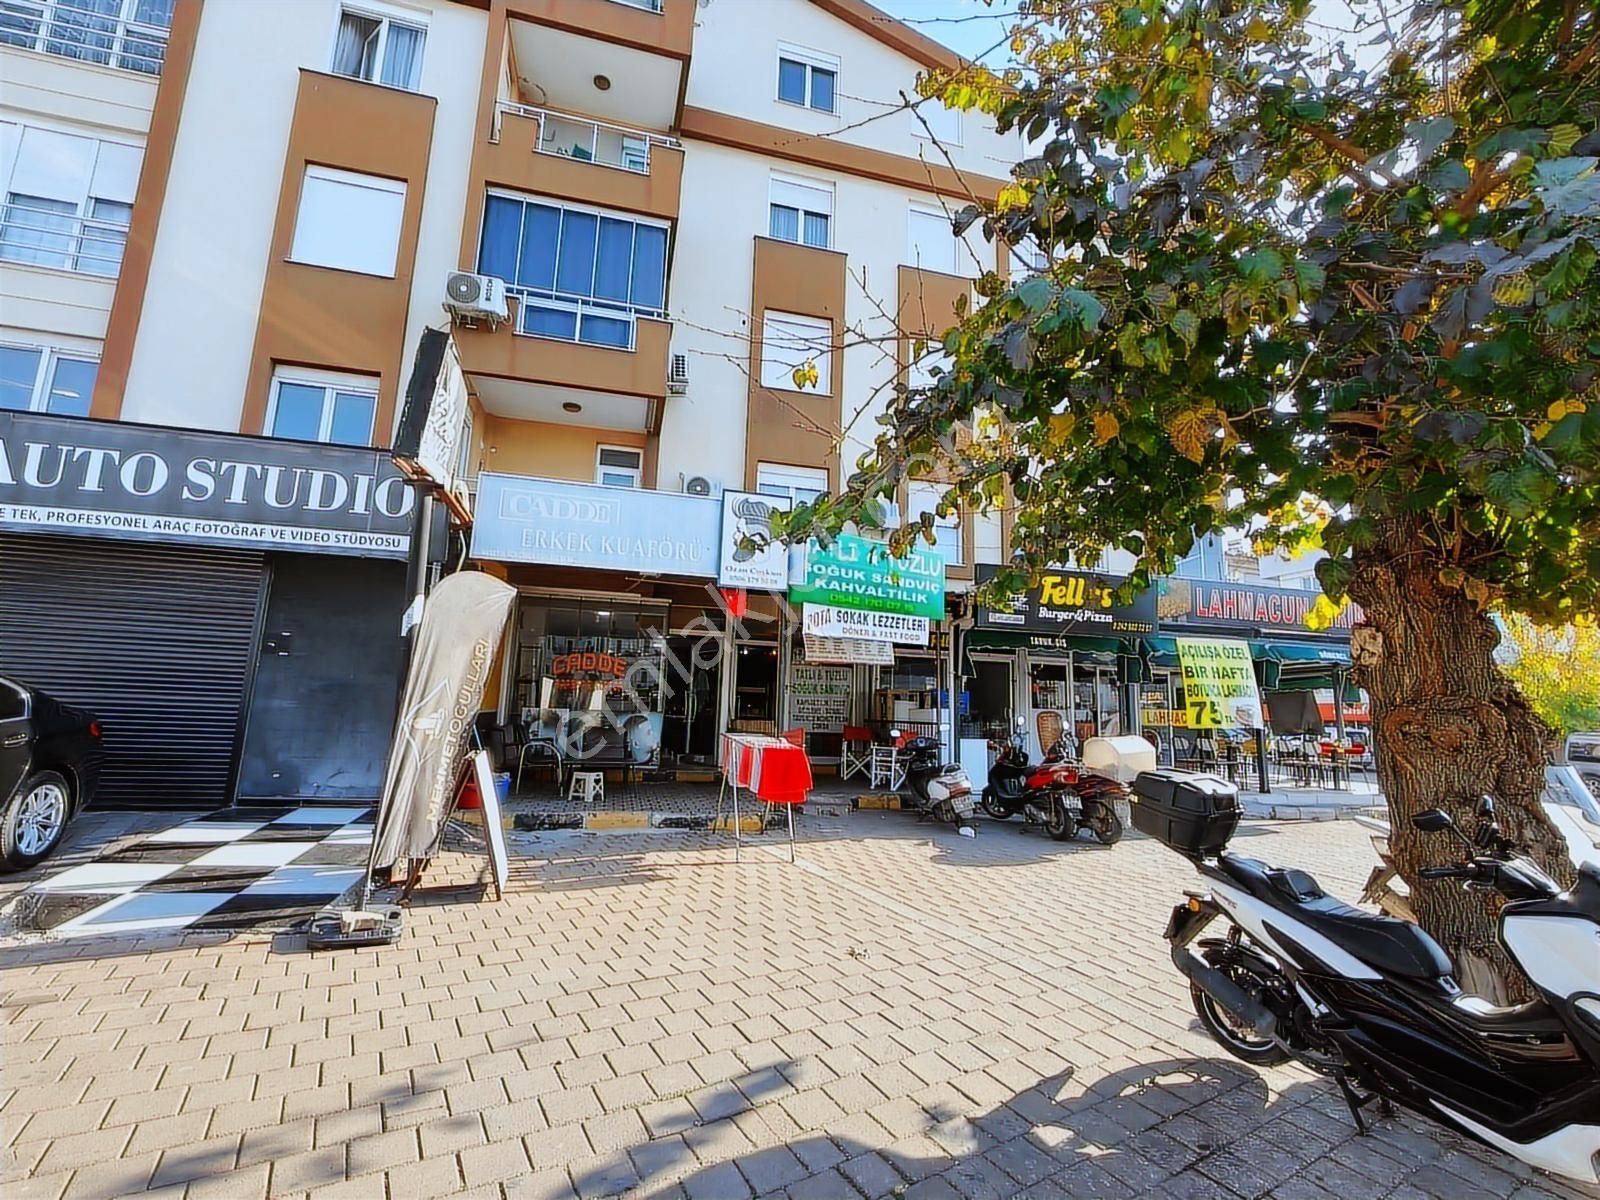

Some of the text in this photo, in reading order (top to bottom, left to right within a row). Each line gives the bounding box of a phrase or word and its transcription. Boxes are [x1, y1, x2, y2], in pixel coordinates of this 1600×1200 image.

[182, 458, 415, 518] STUDIO
[508, 495, 612, 525] CADDE
[11, 508, 41, 523] TEK,
[47, 511, 148, 529] PROFESYONEL
[153, 519, 190, 534] ARAÇ
[194, 522, 266, 538] FOTOĞRAF
[271, 529, 286, 540] VE
[334, 532, 401, 549] STÜDYOSU
[522, 528, 593, 553] ERKEK
[601, 535, 704, 562] KUAFÖRÜ
[815, 577, 928, 604] KAHVALTILIK
[836, 609, 870, 627] SOKAK
[553, 652, 626, 677] CADDE
[1223, 644, 1249, 660] ÖZEL
[1185, 663, 1208, 679] BİR
[1146, 710, 1188, 725] LAHAC
[1190, 701, 1223, 725] 75
